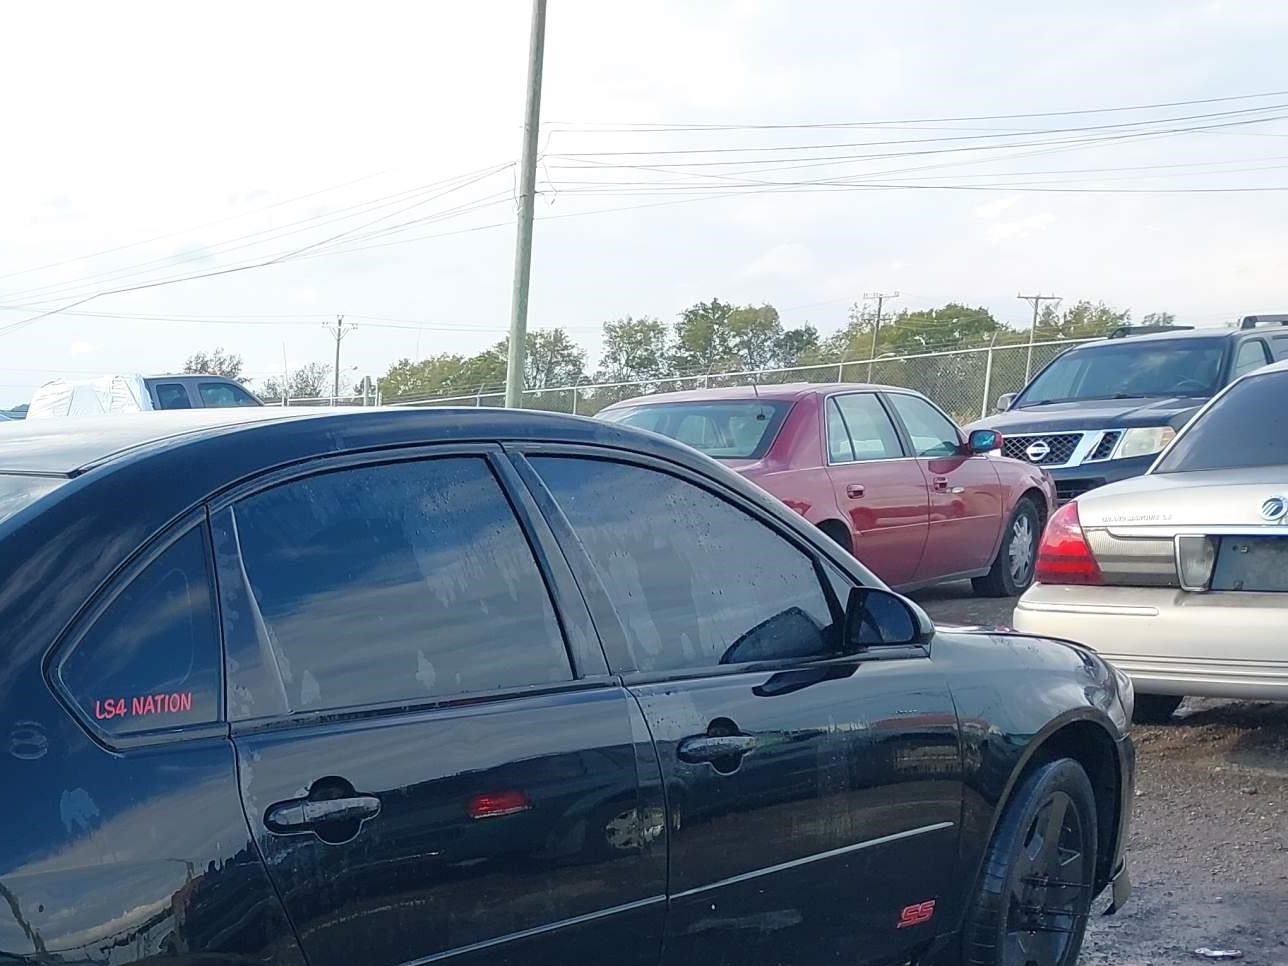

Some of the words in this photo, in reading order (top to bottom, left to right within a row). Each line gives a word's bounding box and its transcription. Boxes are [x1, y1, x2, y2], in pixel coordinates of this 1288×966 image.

[95, 698, 127, 719] LS4
[132, 692, 192, 716] NATION
[896, 899, 936, 929] SS
